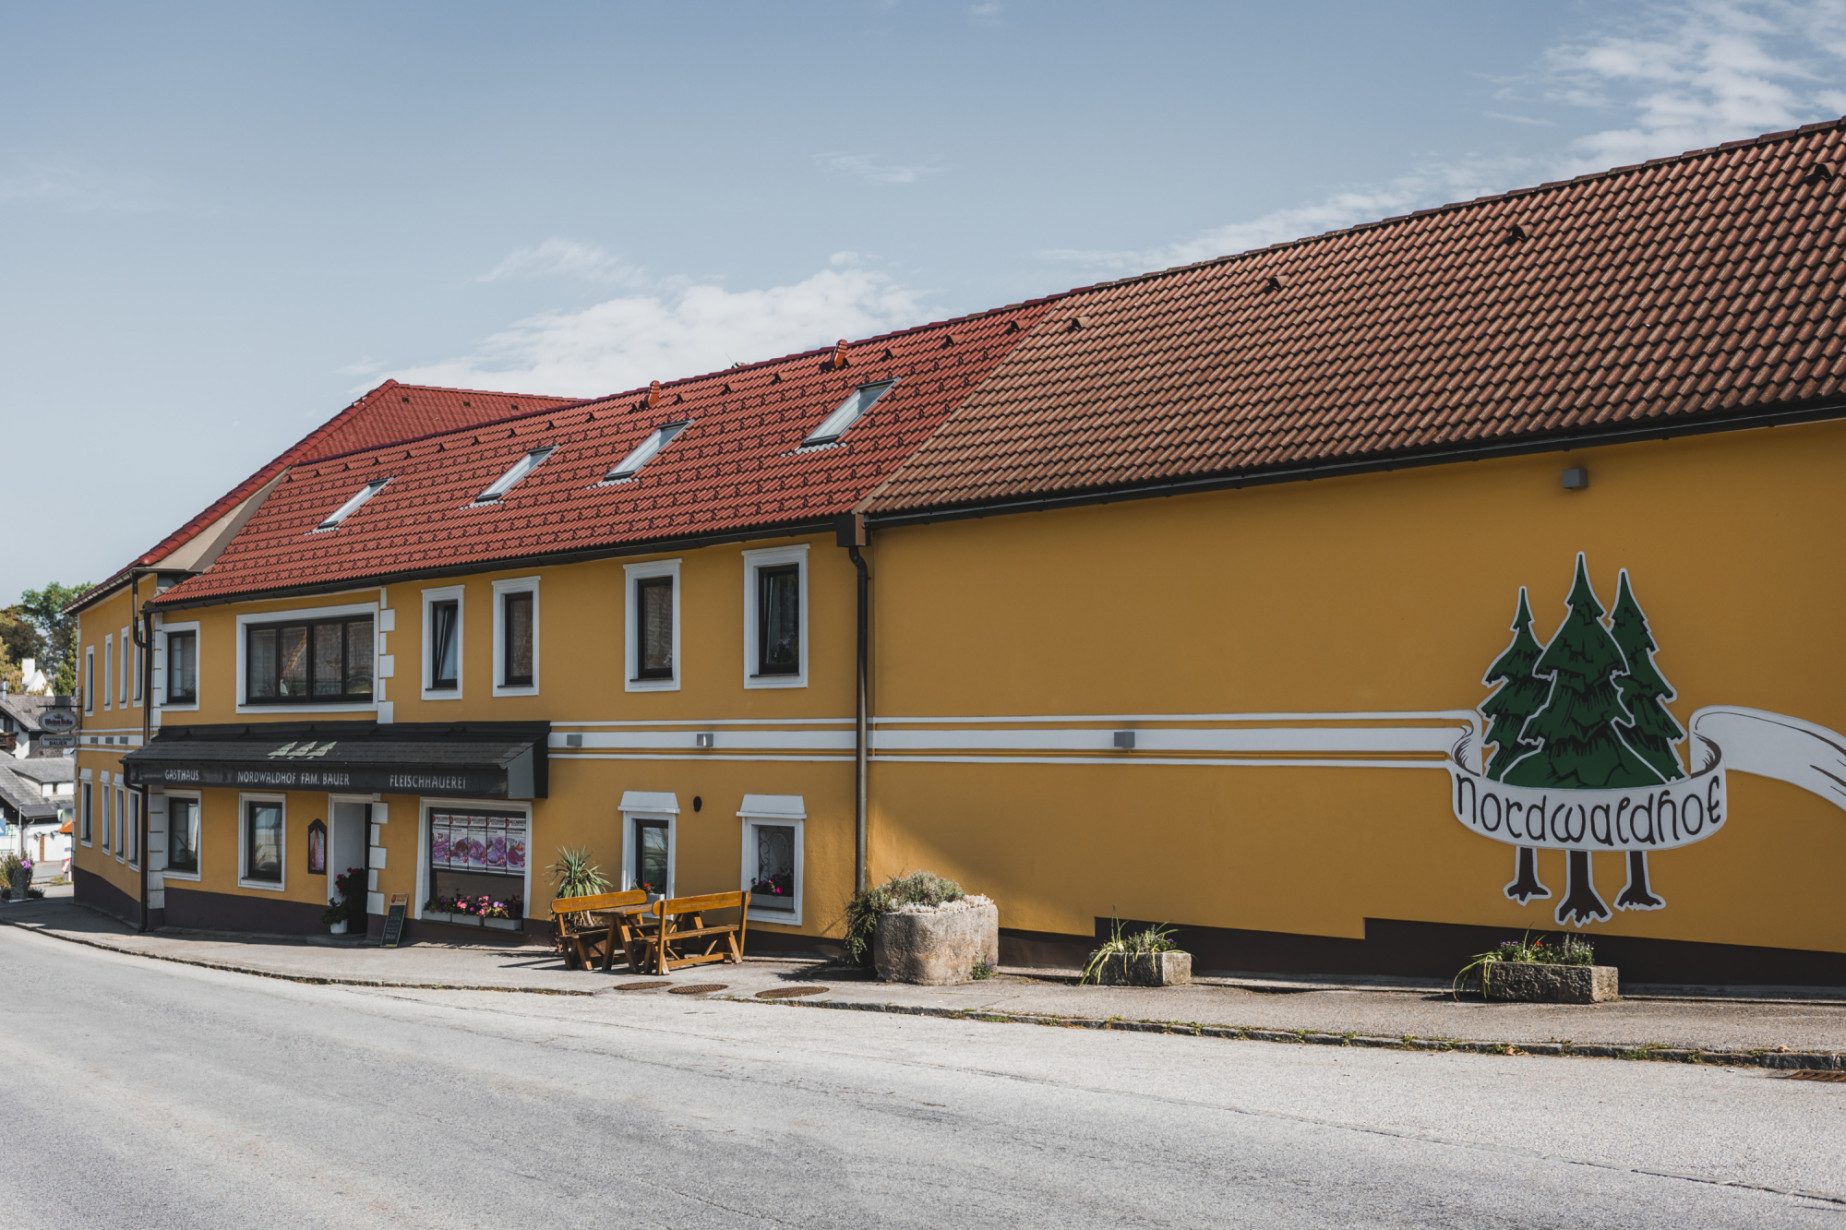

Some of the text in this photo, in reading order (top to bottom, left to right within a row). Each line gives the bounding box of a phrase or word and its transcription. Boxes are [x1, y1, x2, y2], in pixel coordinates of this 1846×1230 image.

[164, 769, 200, 781] GASTHAUS
[237, 771, 350, 786] NORDWALDHOF FAM. BAUER
[389, 774, 466, 789] FLEISCHHAUEREI
